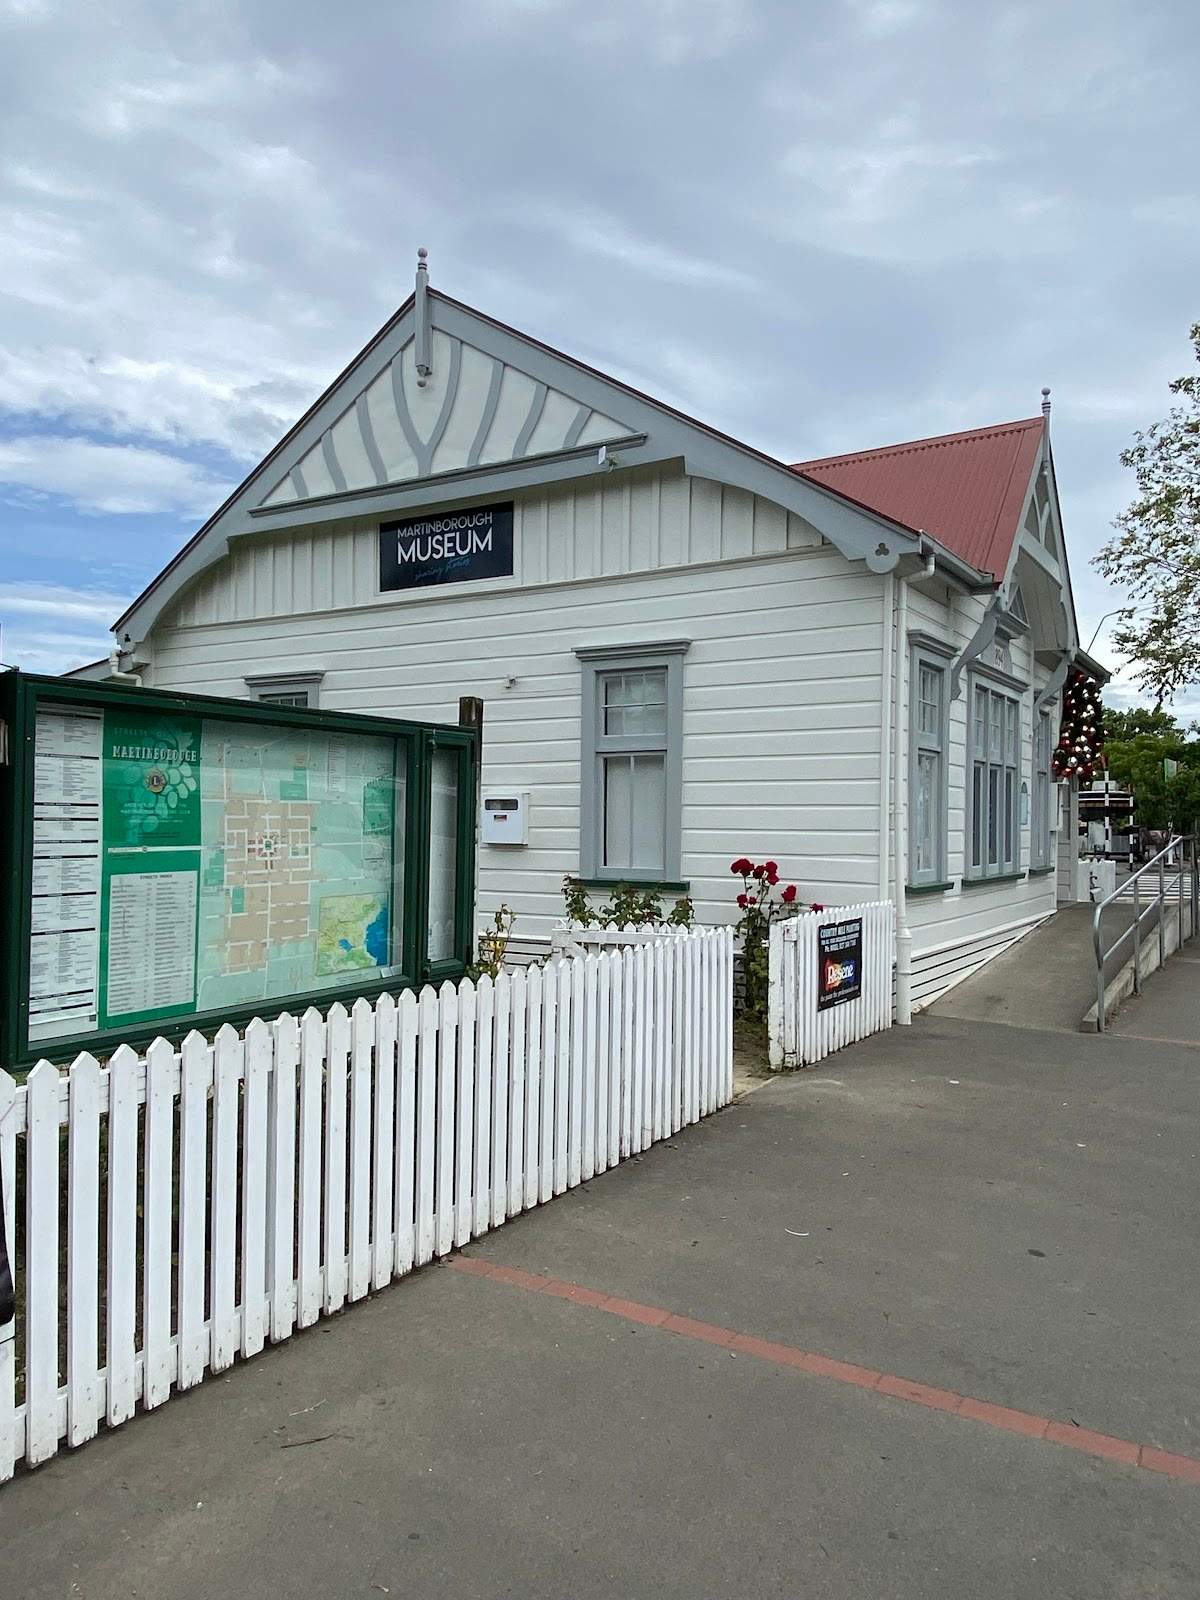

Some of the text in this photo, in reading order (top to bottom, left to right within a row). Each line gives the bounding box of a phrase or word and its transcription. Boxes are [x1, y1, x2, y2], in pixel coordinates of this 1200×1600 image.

[397, 512, 493, 539] MARTINBOROUGH
[397, 527, 492, 565] MUSEUM
[827, 964, 854, 985] Resene
